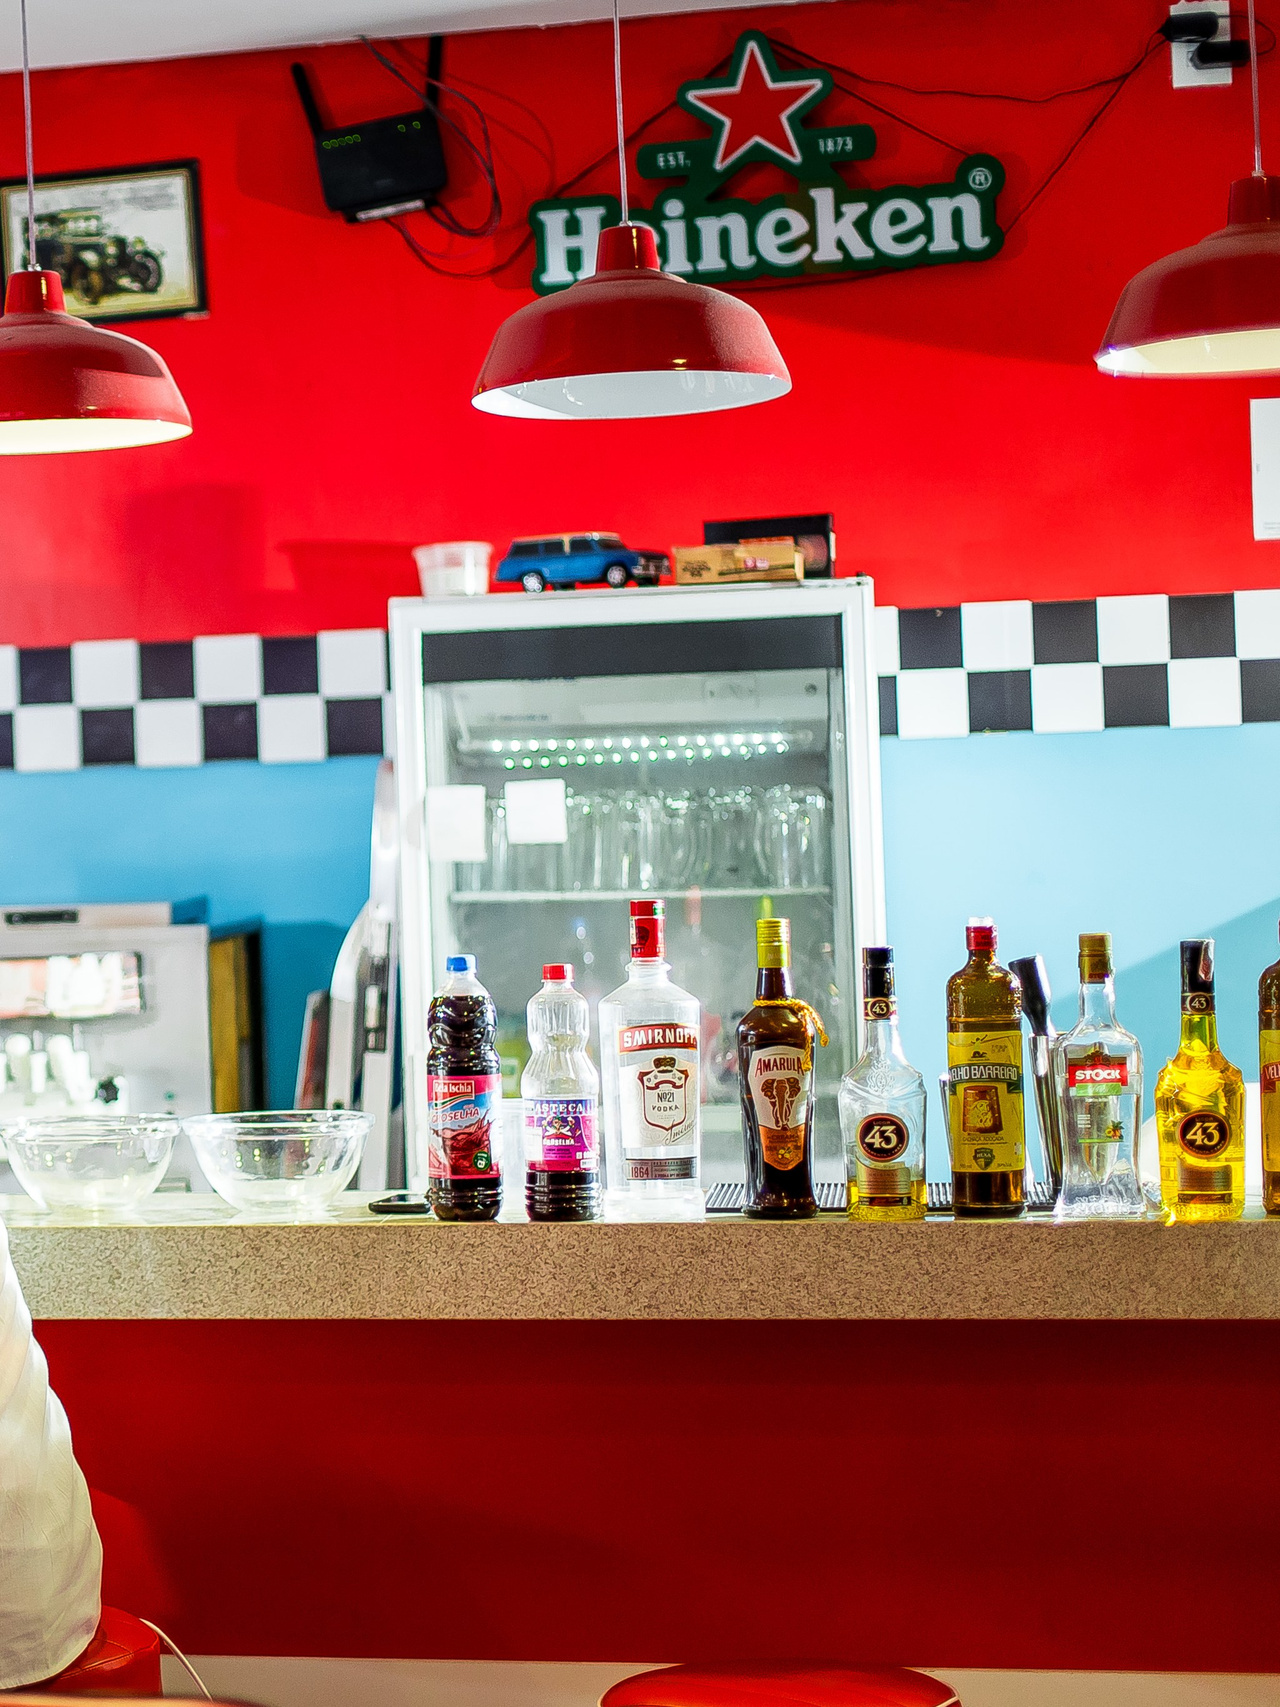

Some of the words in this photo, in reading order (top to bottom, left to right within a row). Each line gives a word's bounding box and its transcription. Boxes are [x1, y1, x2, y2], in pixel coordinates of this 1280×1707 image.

[818, 136, 853, 154] 1873
[536, 187, 992, 286] Hineken
[872, 1003, 887, 1014] 43
[1191, 997, 1207, 1009] 43
[755, 1056, 805, 1078] AMARULA
[971, 1065, 1018, 1081] BARREIRO
[1075, 1069, 1121, 1081] STOCK
[449, 1082, 472, 1093] Ischia
[535, 1103, 583, 1113] ASTECA
[651, 1104, 680, 1112] VODKA
[864, 1125, 897, 1149] 43
[1185, 1122, 1220, 1146] 43
[631, 1166, 649, 1178] 1864
